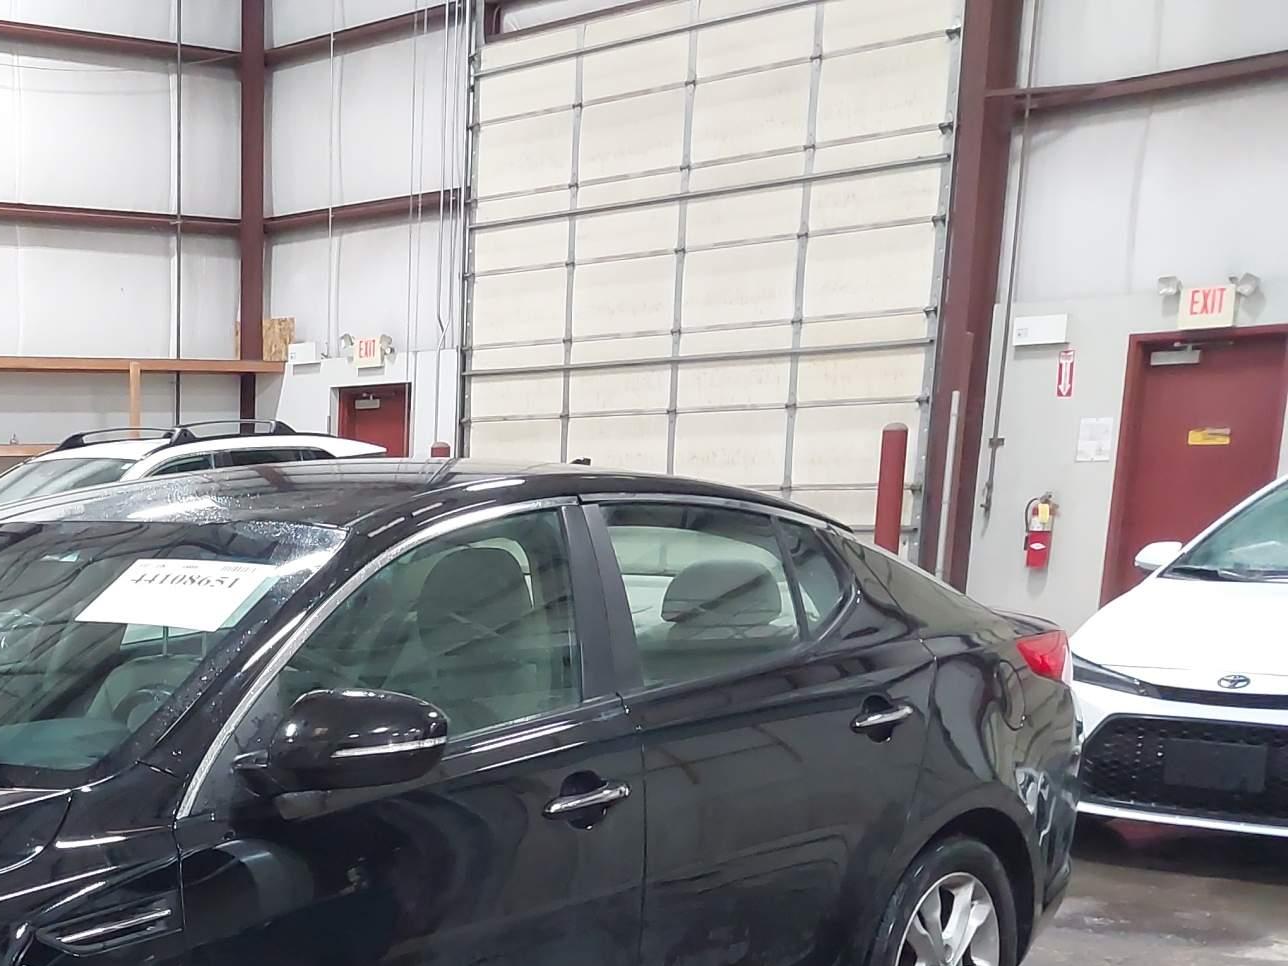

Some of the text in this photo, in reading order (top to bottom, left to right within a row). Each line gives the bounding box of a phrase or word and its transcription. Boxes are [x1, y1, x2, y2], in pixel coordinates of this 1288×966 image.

[1189, 287, 1227, 316] EXIT
[359, 339, 376, 359] EXIT
[130, 573, 240, 589] 44108651
